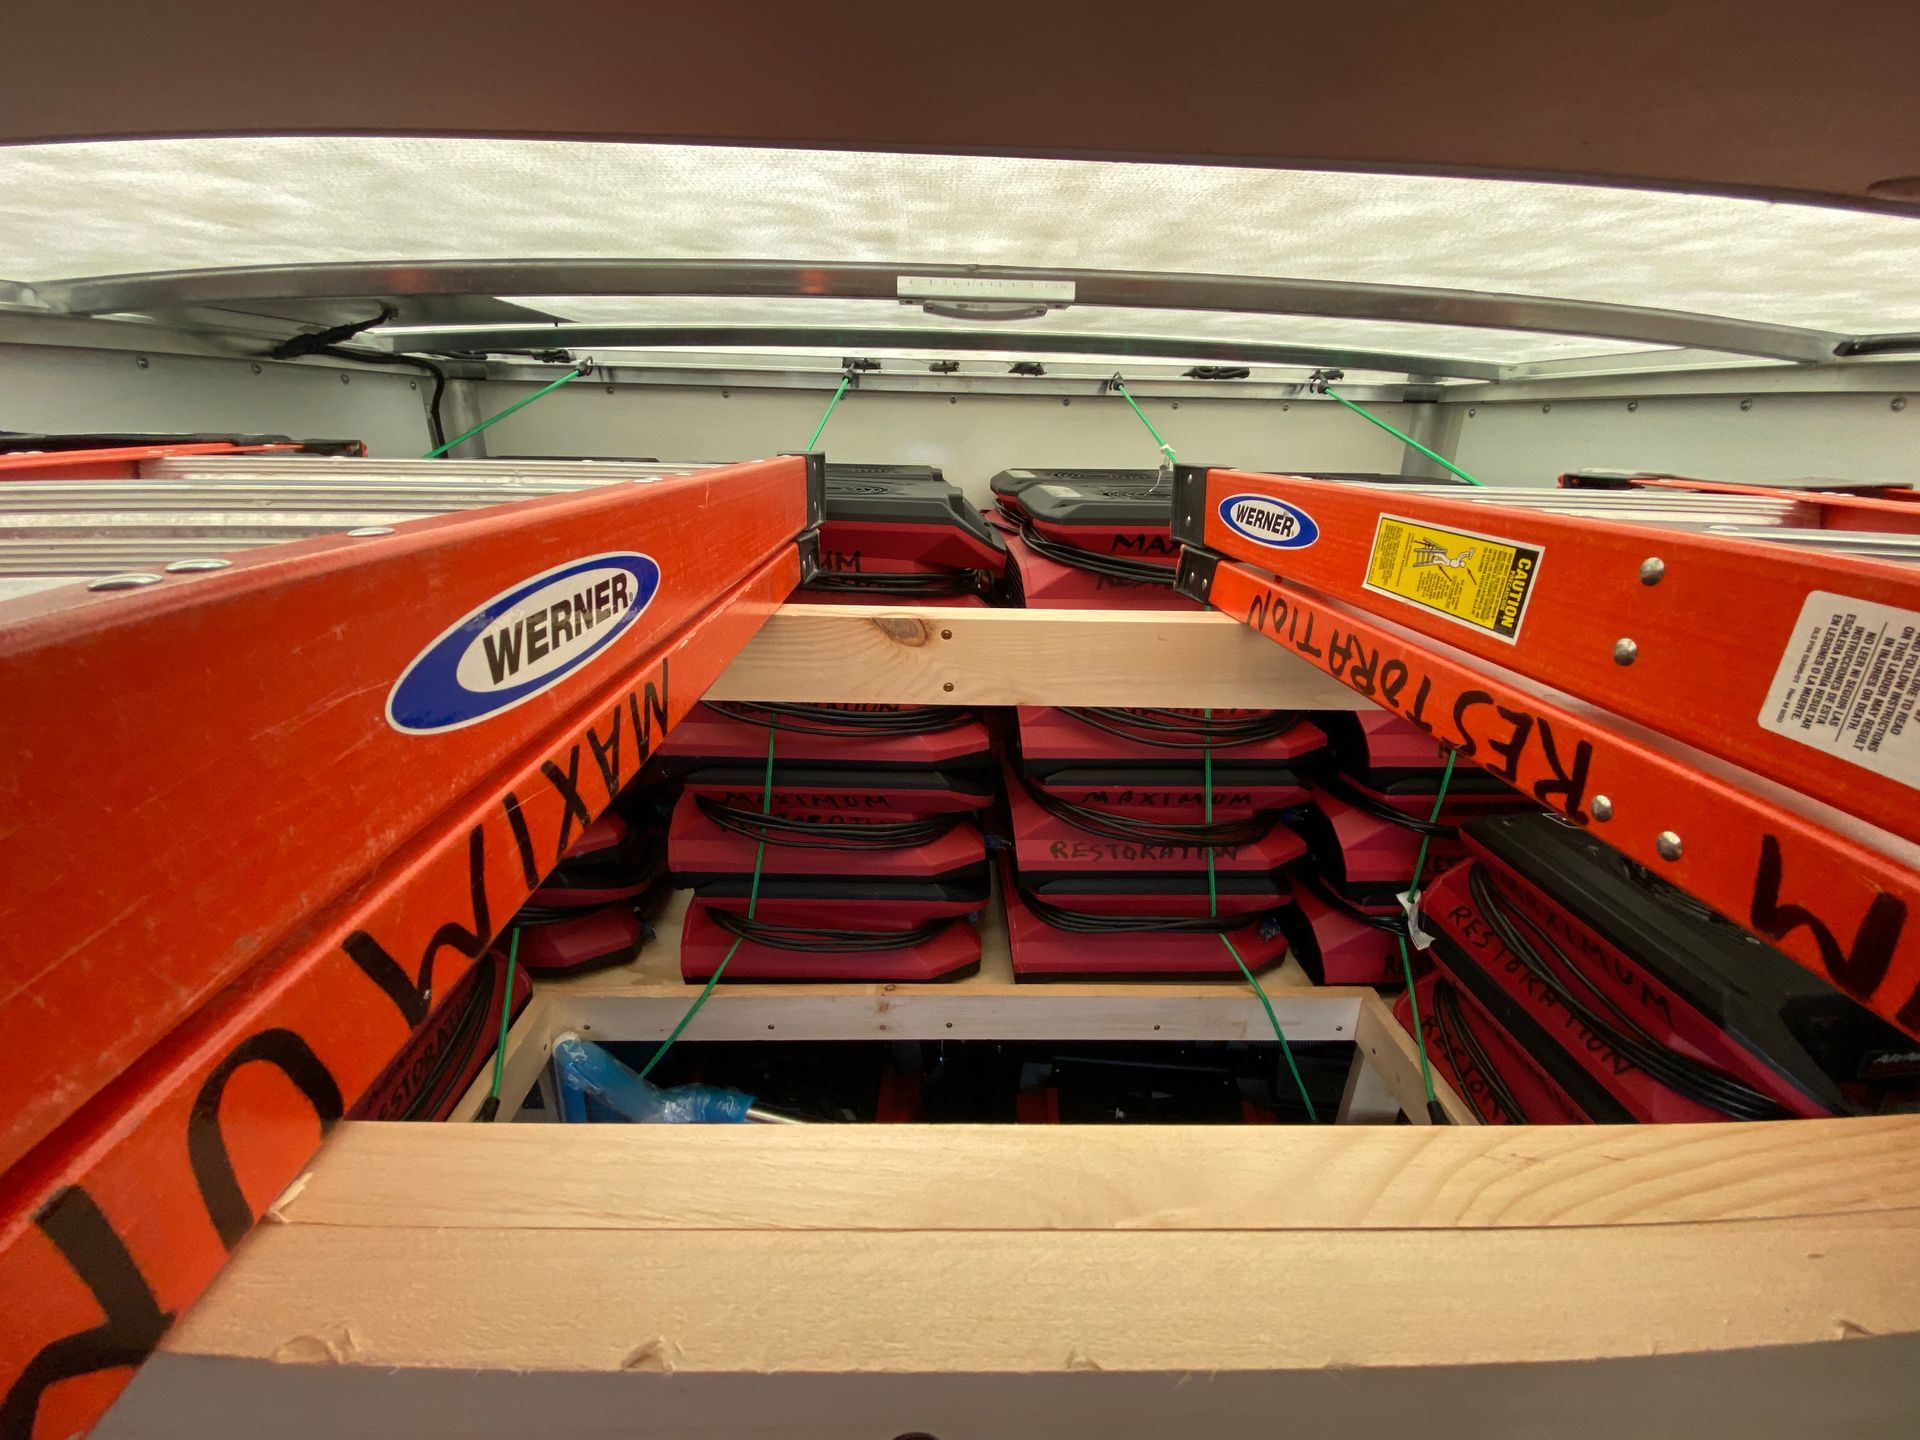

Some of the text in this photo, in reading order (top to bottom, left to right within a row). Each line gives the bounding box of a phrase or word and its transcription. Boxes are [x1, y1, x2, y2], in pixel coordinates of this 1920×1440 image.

[1235, 504, 1294, 537] WERNER
[1500, 557, 1532, 628] CAUTION
[482, 573, 629, 685] WERNER
[1830, 613, 1843, 626] EN
[1832, 613, 1857, 655] ESCALERA
[1813, 627, 1838, 666] LESIONES
[1805, 675, 1818, 686] LA
[1815, 626, 1865, 726] INSTRUCCIONES DE ESTA
[1828, 631, 1877, 728] NO LEER NI SEGUIR LAS
[1846, 636, 1896, 731] IN INJURIES OR DEATH.
[1852, 625, 1915, 752] ON THIS LADDER MAY RESULT
[1894, 653, 1919, 691] FOLLOW
[1247, 589, 1593, 825] RESTORATION
[1791, 686, 1813, 721] MUERTE.
[1800, 688, 1826, 730] RESULTAR
[1867, 691, 1902, 752] INSTRUCTIONS
[1890, 711, 1908, 736] READ
[1901, 699, 1915, 711] TO
[1082, 789, 1254, 806] MAXIMUM
[1050, 840, 1241, 862] RESTORATION
[1447, 904, 1638, 1077] RESTORATION
